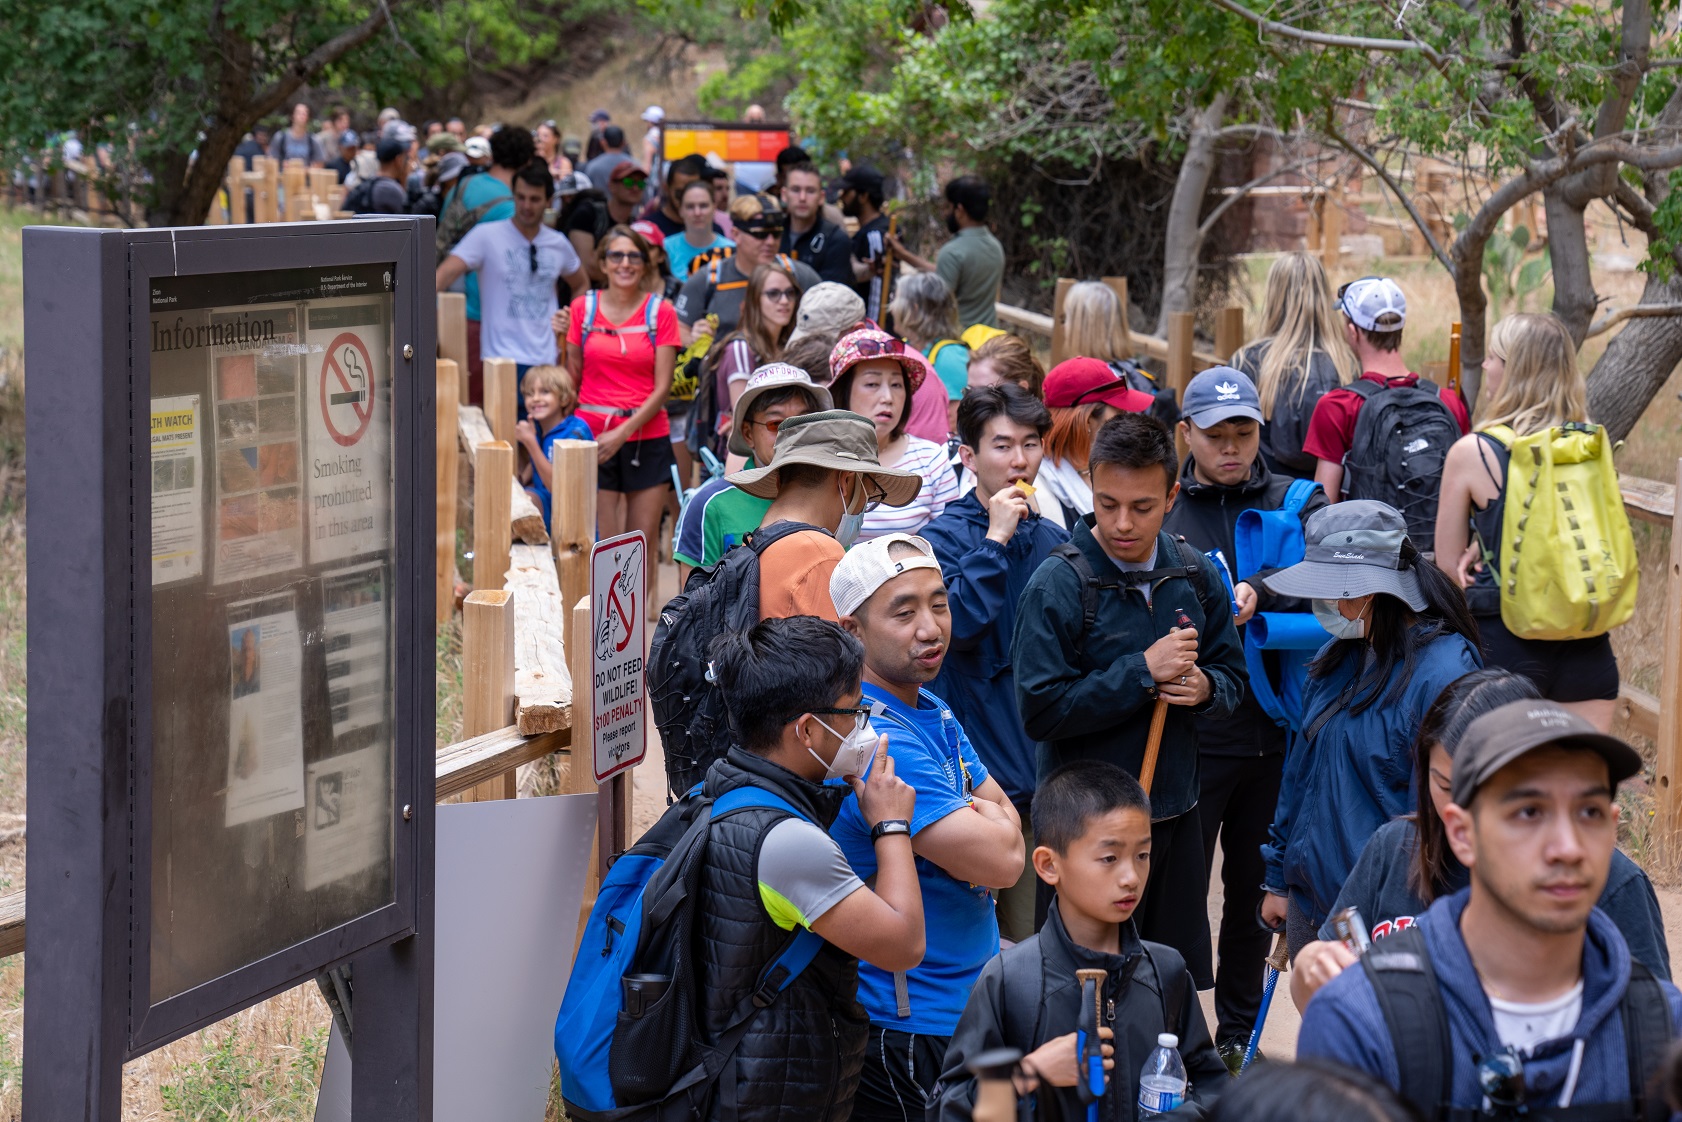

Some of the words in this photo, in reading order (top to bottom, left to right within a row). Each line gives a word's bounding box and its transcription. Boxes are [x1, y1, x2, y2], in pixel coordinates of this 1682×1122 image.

[152, 296, 168, 304] National
[151, 312, 275, 352] Information
[754, 366, 798, 384] STANFORD
[164, 414, 193, 428] WATCH
[174, 431, 193, 441] PRESENT
[313, 454, 362, 479] Smoking
[313, 480, 373, 516] prohibited
[315, 521, 326, 540] in
[328, 516, 349, 537] this
[351, 515, 374, 533] area
[595, 671, 606, 689] DO
[607, 664, 622, 684] NOT
[623, 657, 642, 677] FEED
[602, 678, 638, 706] WILDLIFE!
[595, 711, 610, 731] $100
[611, 697, 643, 723] PENALTY
[602, 729, 619, 744] Please
[619, 720, 636, 737] report
